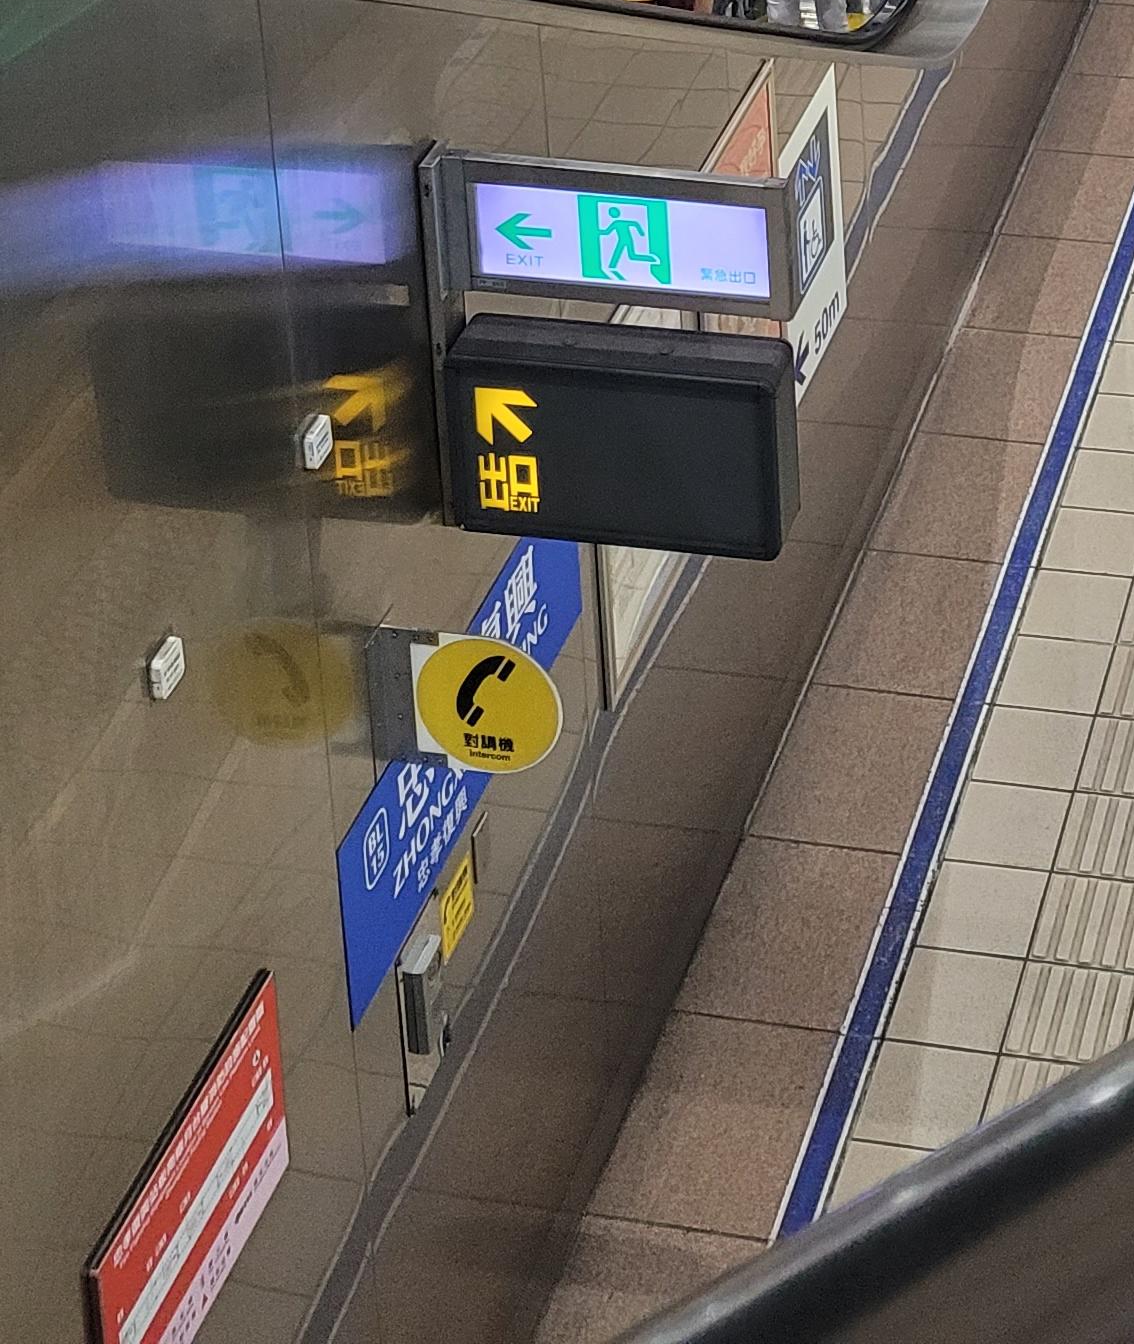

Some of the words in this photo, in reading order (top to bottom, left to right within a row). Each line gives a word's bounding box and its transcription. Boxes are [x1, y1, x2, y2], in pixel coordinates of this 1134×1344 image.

[506, 253, 544, 267] EXIT
[701, 267, 756, 285] 緊急出口
[814, 291, 841, 355] 50m
[478, 452, 539, 511] 出口
[510, 496, 541, 513] EXIT
[464, 733, 515, 753] 對講機
[469, 749, 511, 762] Intercom
[368, 822, 384, 857] BL
[371, 845, 385, 876] 15
